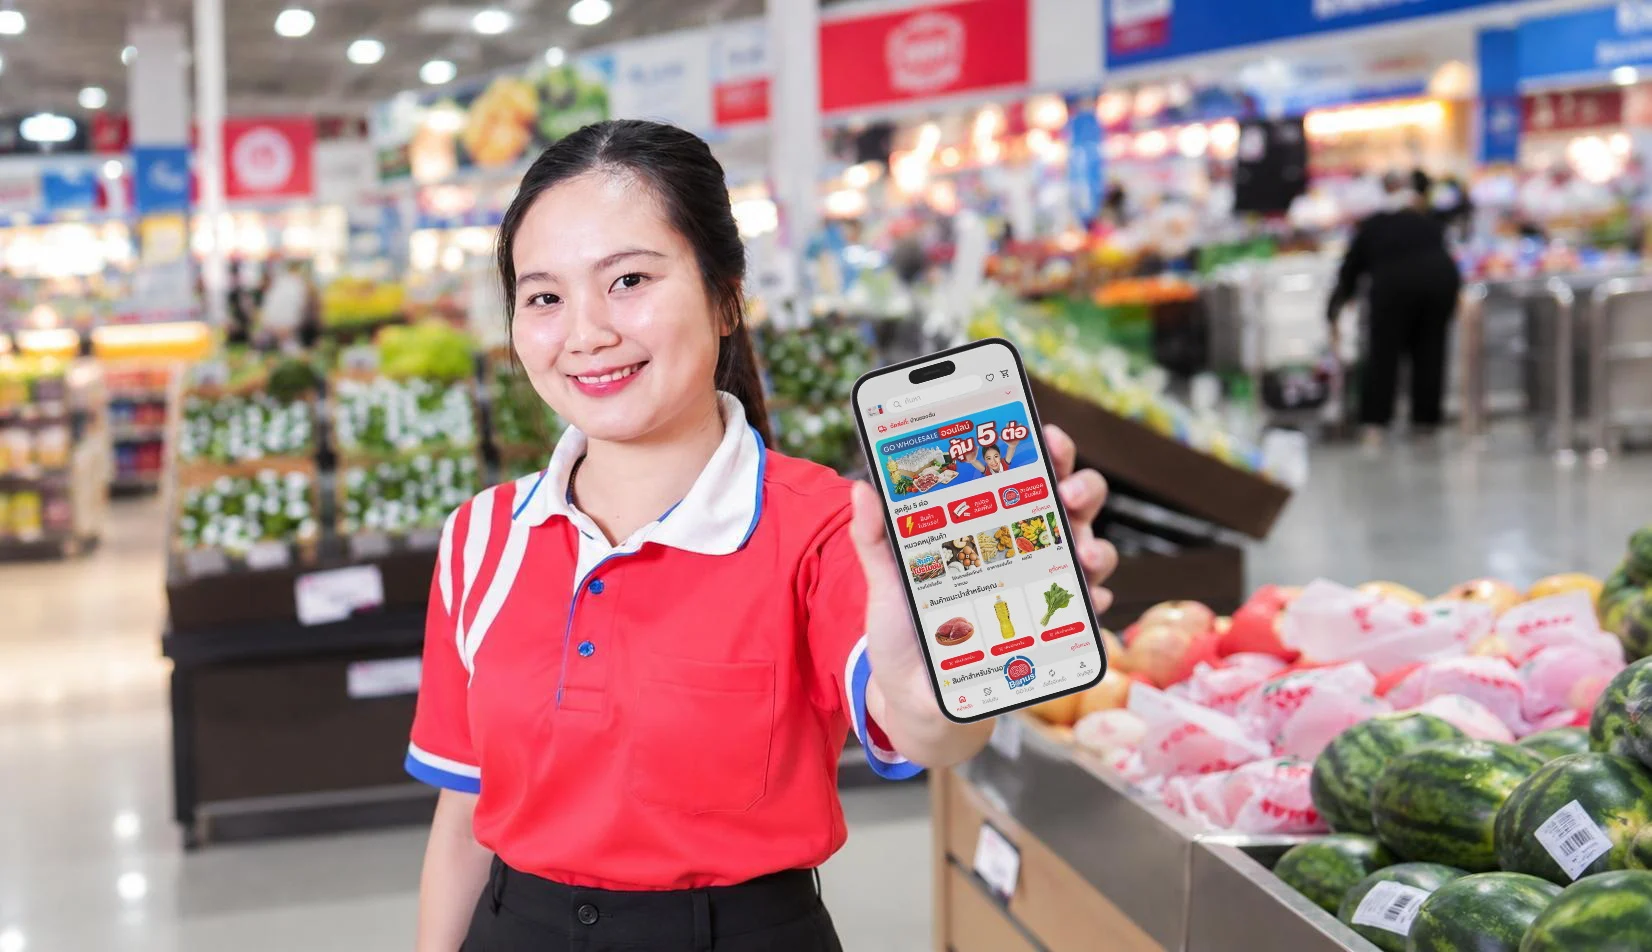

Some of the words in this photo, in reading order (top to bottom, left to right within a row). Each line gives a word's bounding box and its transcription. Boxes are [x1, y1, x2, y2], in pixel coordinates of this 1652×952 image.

[884, 444, 896, 452] GO
[897, 432, 938, 448] WHOLESALE
[940, 422, 970, 436] ออนไลน์
[950, 439, 974, 460] คุ้ม
[978, 422, 996, 446] 5
[1002, 422, 1027, 440] ต่อ
[894, 504, 912, 515] สุดคุ้ม
[920, 514, 934, 522] สินค้า
[904, 532, 946, 550] หมวดหมู่สินค้า
[930, 582, 998, 606] สินค้าแนะนำสำหรับคุณ
[952, 664, 1008, 685] สินค้าสำหรับร้านอ
[1009, 674, 1035, 690] Bonus
